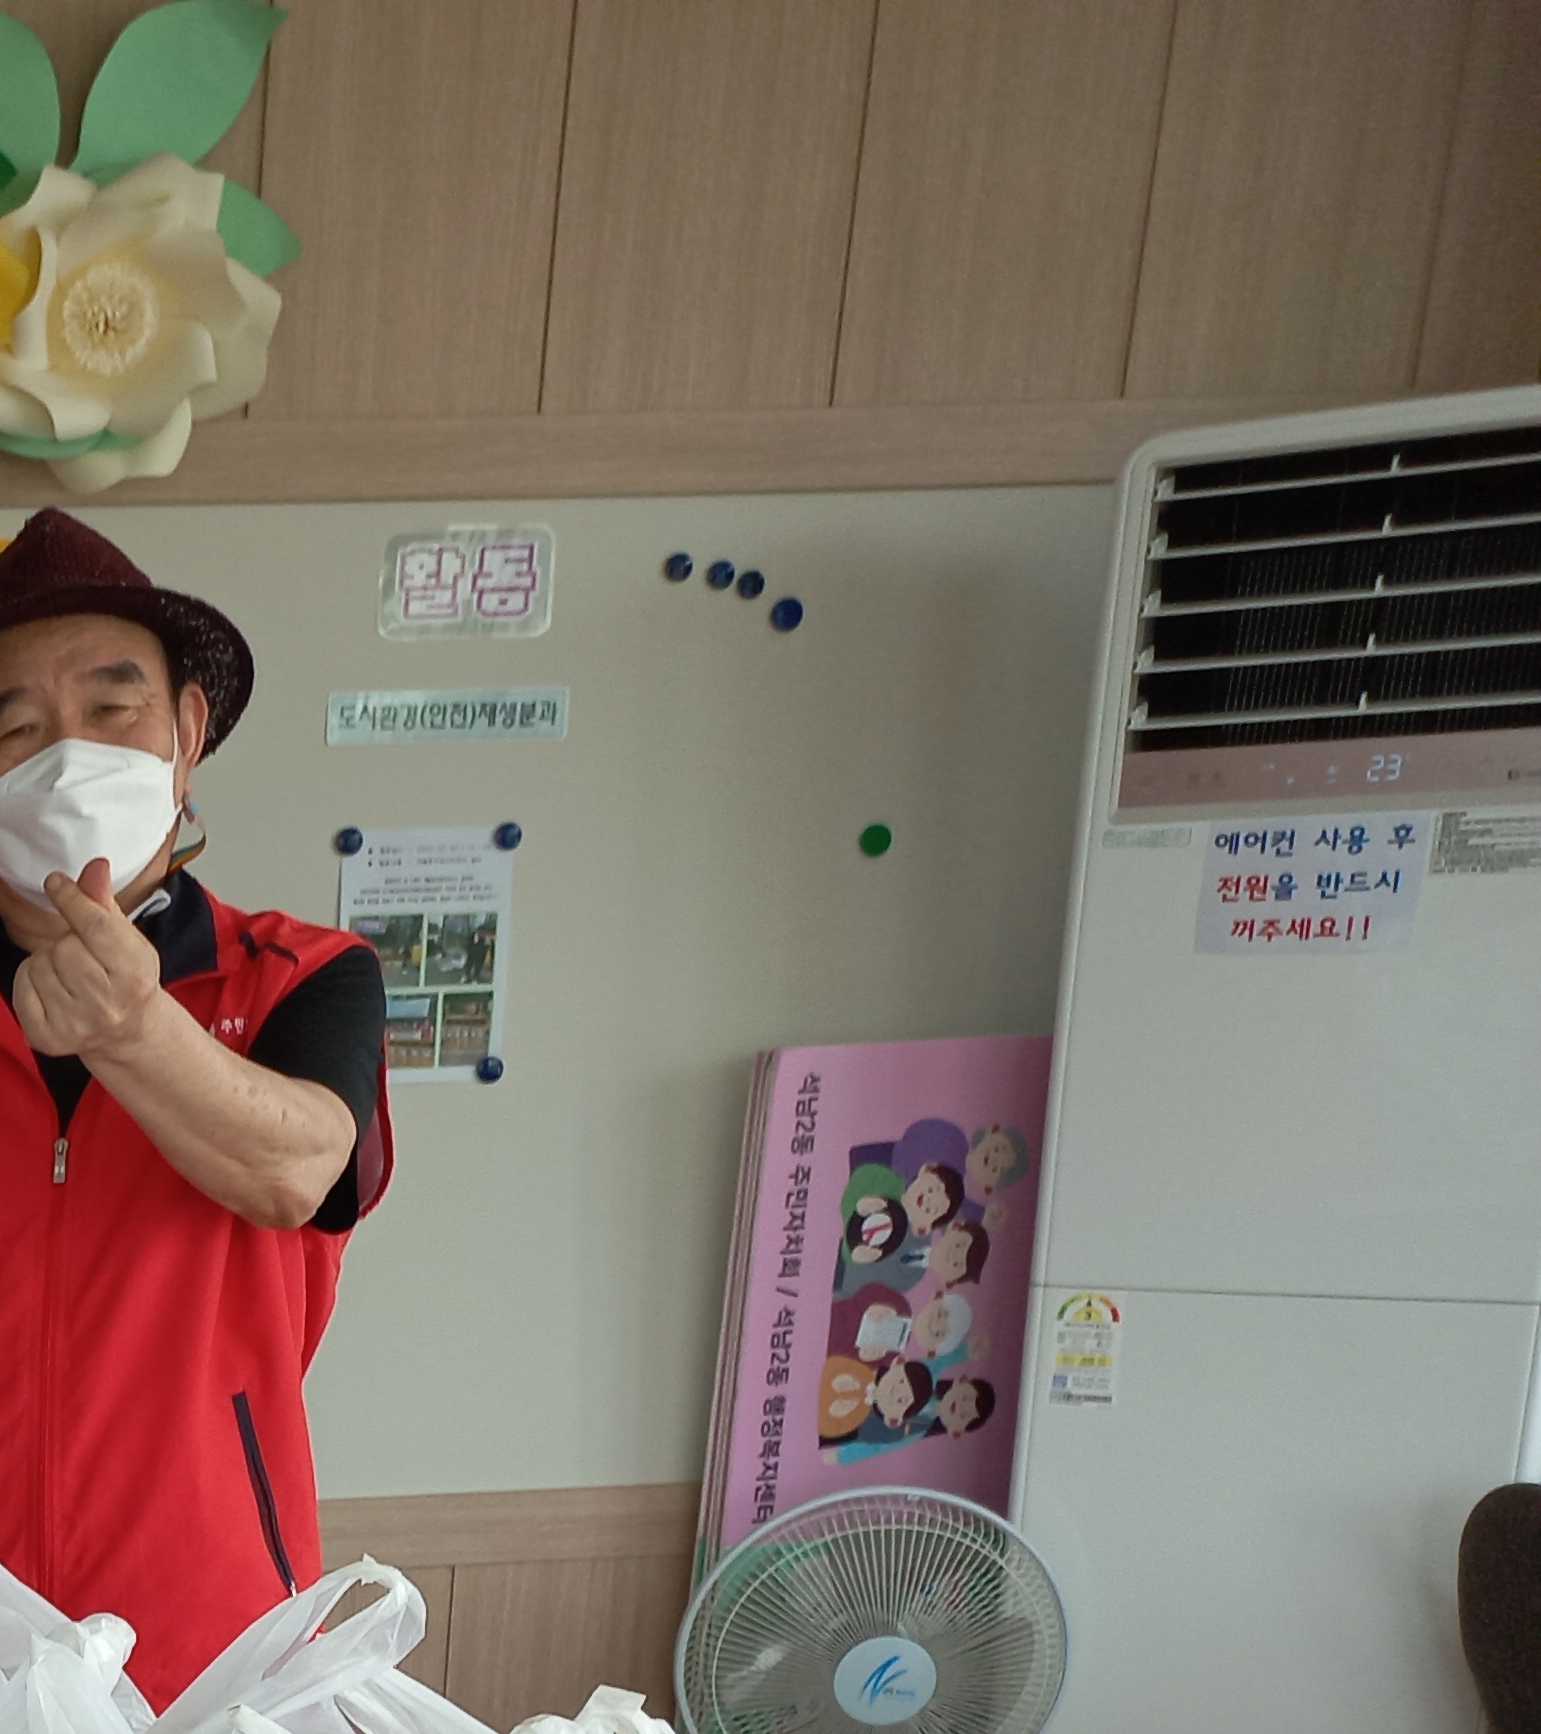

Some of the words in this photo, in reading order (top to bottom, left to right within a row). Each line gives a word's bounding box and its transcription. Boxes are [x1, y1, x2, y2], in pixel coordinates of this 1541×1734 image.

[399, 542, 537, 620] 활동
[338, 700, 558, 732] 도시환경(안전)재생분과
[1367, 754, 1403, 783] 23
[1214, 828, 1296, 858] 에어컨
[1314, 825, 1370, 855] 사용
[1387, 823, 1415, 850] 후
[1217, 872, 1298, 903] 전원을
[1316, 869, 1401, 900] 반드시
[1231, 915, 1371, 943] 꺼주세요!!
[790, 1072, 821, 1156] 석남2동
[777, 1163, 812, 1278] 주민자치회
[766, 1305, 795, 1388] 석남2동
[751, 1395, 787, 1525] 행정복지센터
